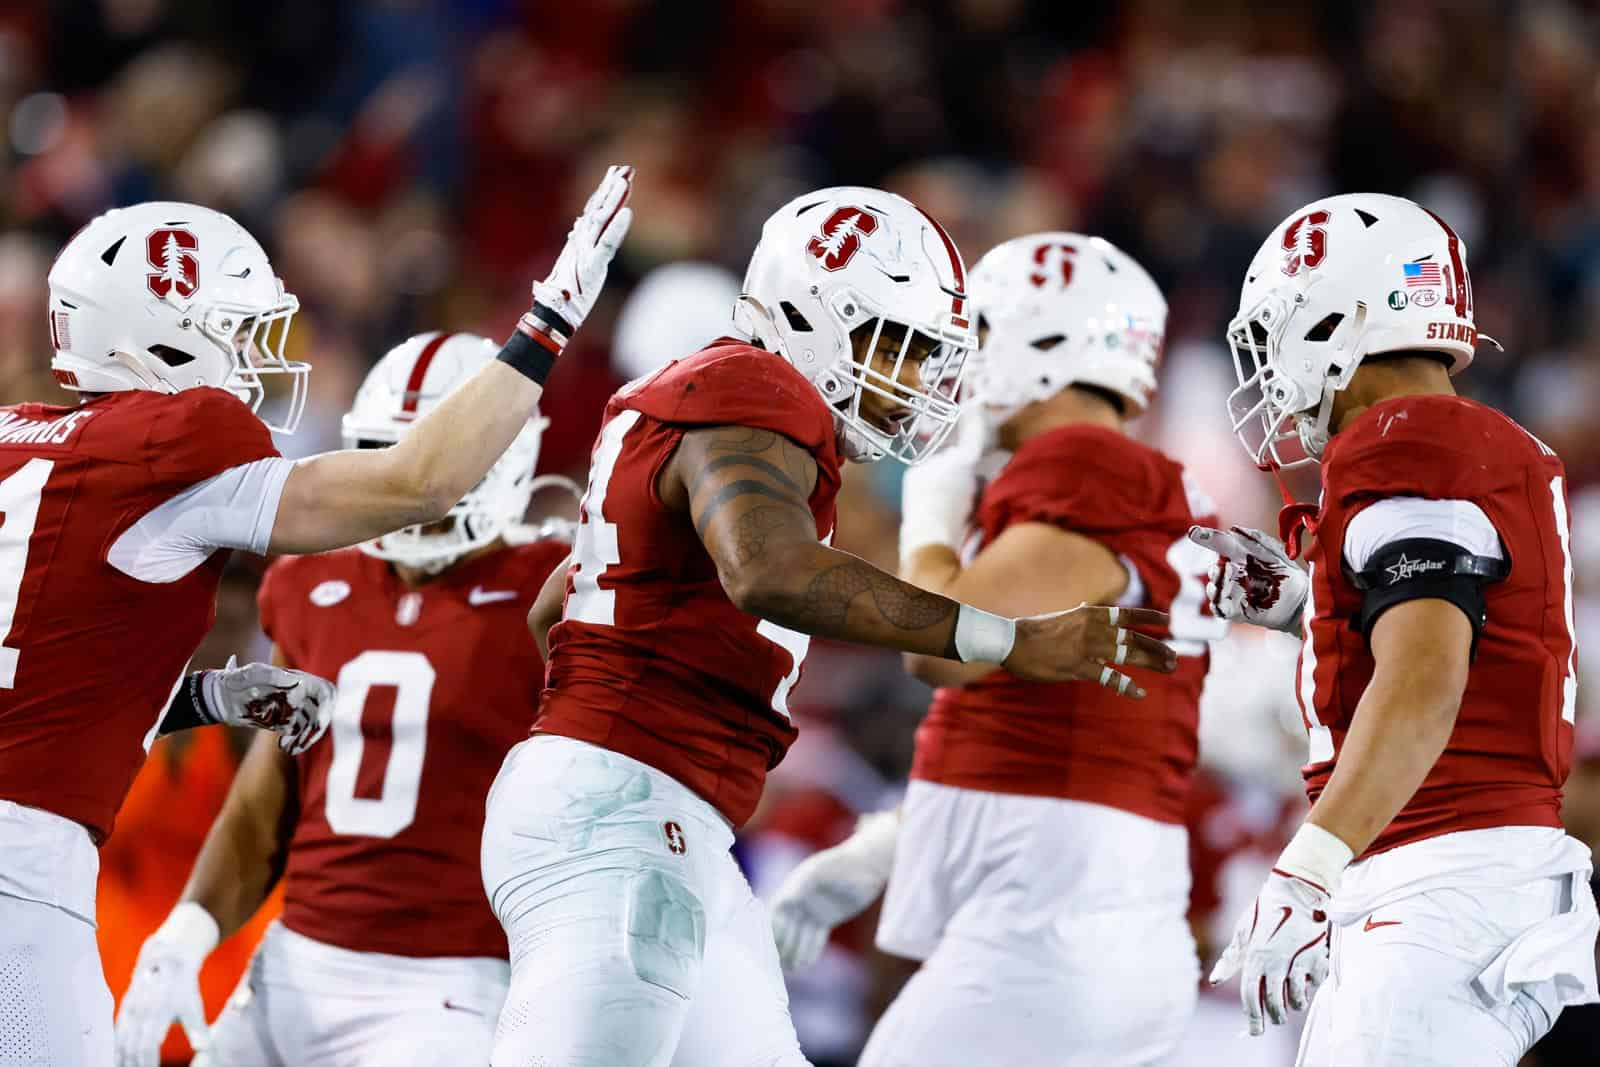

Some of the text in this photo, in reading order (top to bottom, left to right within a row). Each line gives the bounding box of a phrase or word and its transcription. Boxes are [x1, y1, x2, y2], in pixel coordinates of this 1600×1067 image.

[145, 228, 200, 299] S
[1426, 321, 1478, 348] STANF
[324, 650, 437, 838] 0
